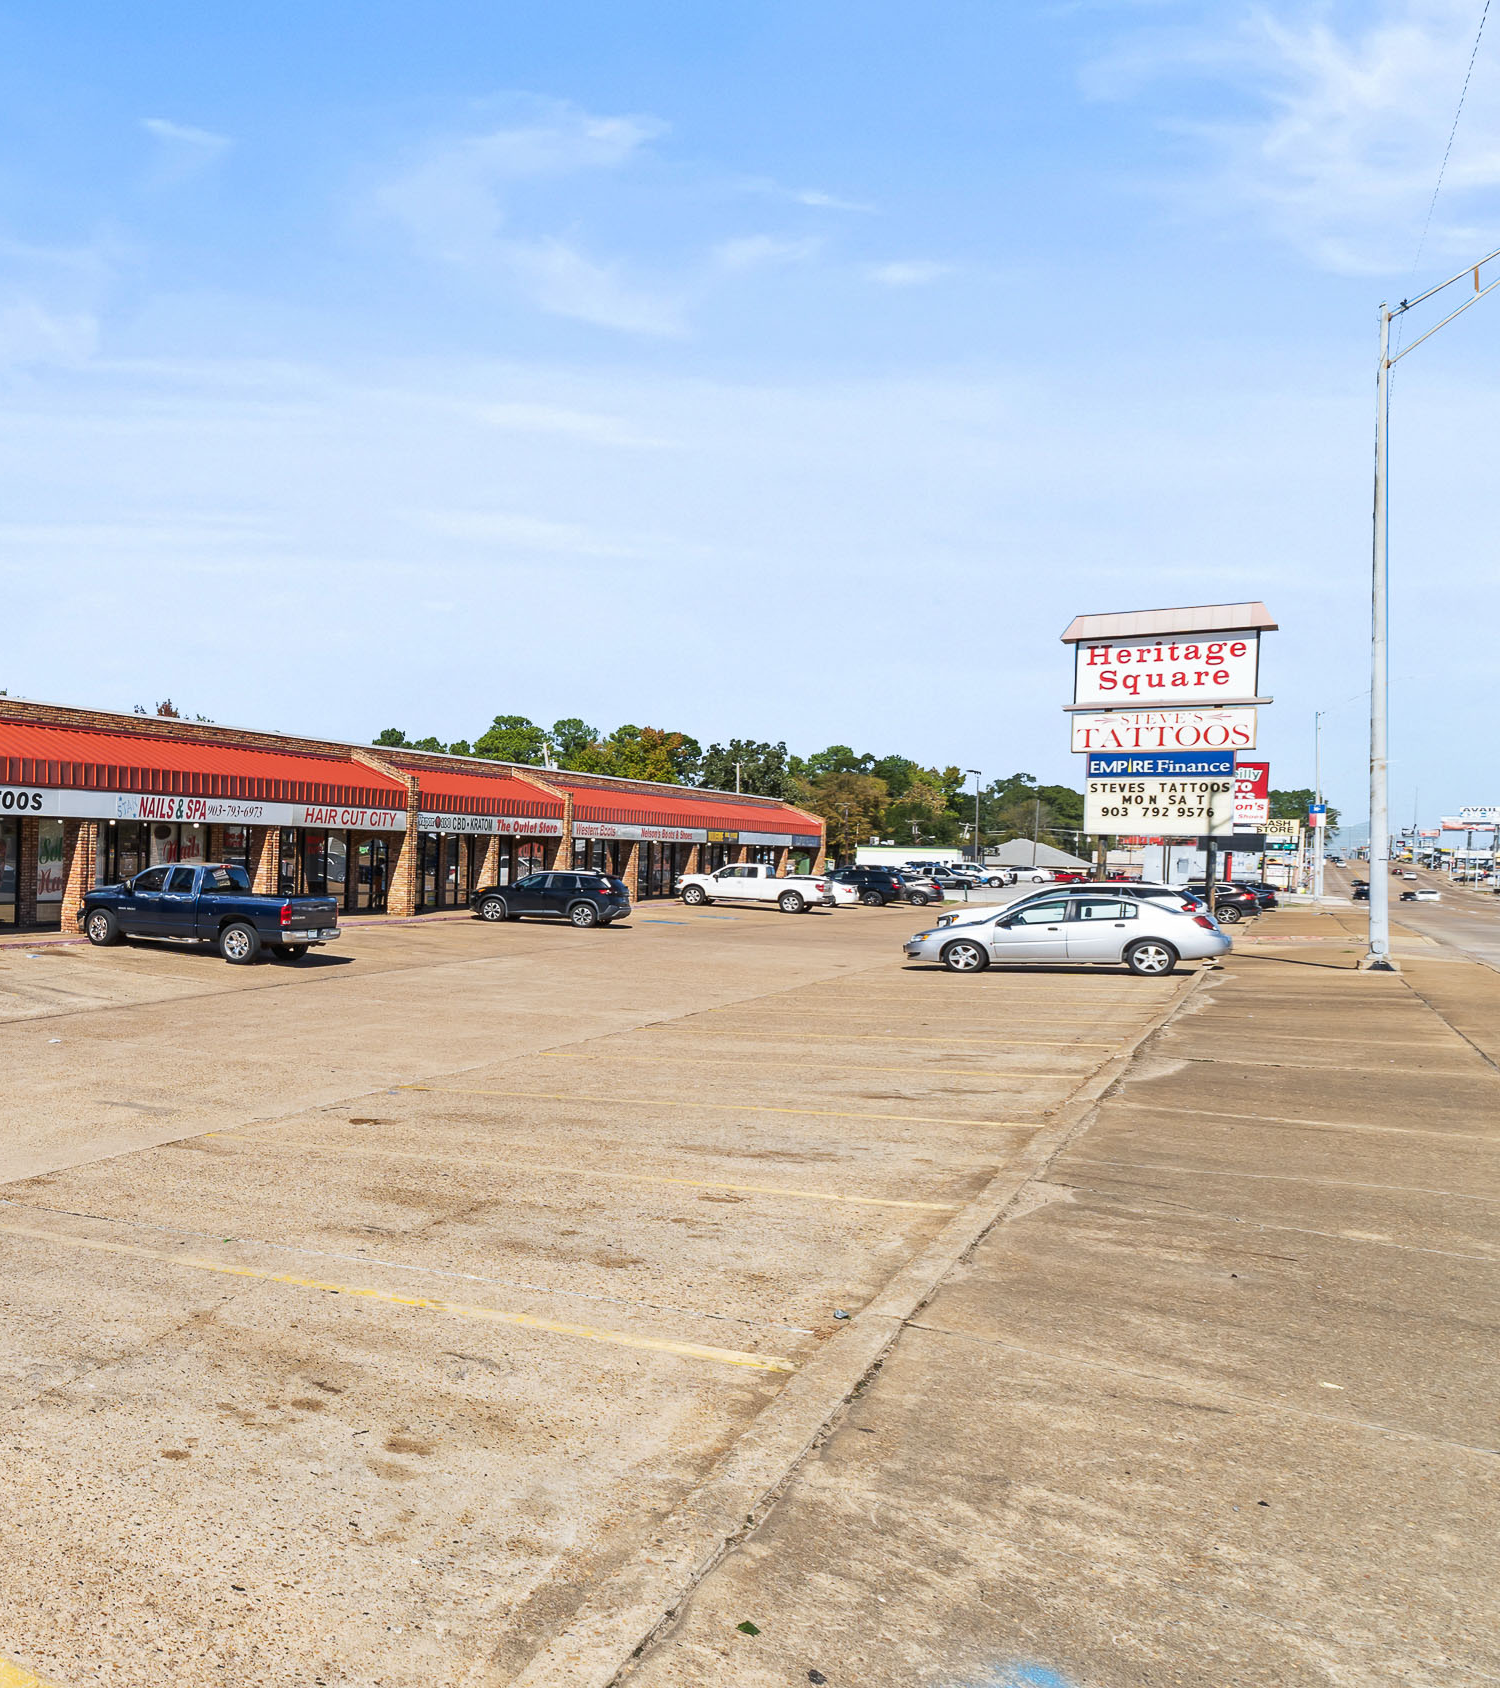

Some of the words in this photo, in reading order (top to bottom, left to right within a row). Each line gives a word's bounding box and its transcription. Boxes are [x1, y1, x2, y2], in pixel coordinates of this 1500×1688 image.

[1086, 641, 1247, 666] Heritage
[1099, 669, 1230, 695] Square
[1120, 712, 1204, 725] STEVE'S
[1077, 724, 1251, 749] TATTOOS
[1090, 758, 1154, 774] EMPIRE
[1156, 759, 1231, 773] Finance
[1090, 783, 1146, 794] STEVES
[1159, 782, 1231, 793] TATTOOS
[139, 796, 176, 819] NAILS
[175, 799, 185, 819] &
[186, 799, 207, 820] SPA
[208, 804, 263, 818] 903-793-6973
[1122, 795, 1158, 805] MON
[304, 807, 338, 825] HAIR
[341, 809, 367, 826] CUT
[369, 811, 397, 827] CITY
[1101, 807, 1129, 818] 903
[1142, 807, 1169, 817] 792
[1177, 807, 1215, 818] 9576
[496, 819, 511, 832] The
[513, 820, 538, 833] Outlet
[539, 821, 558, 833] Store
[163, 834, 200, 863] Nails
